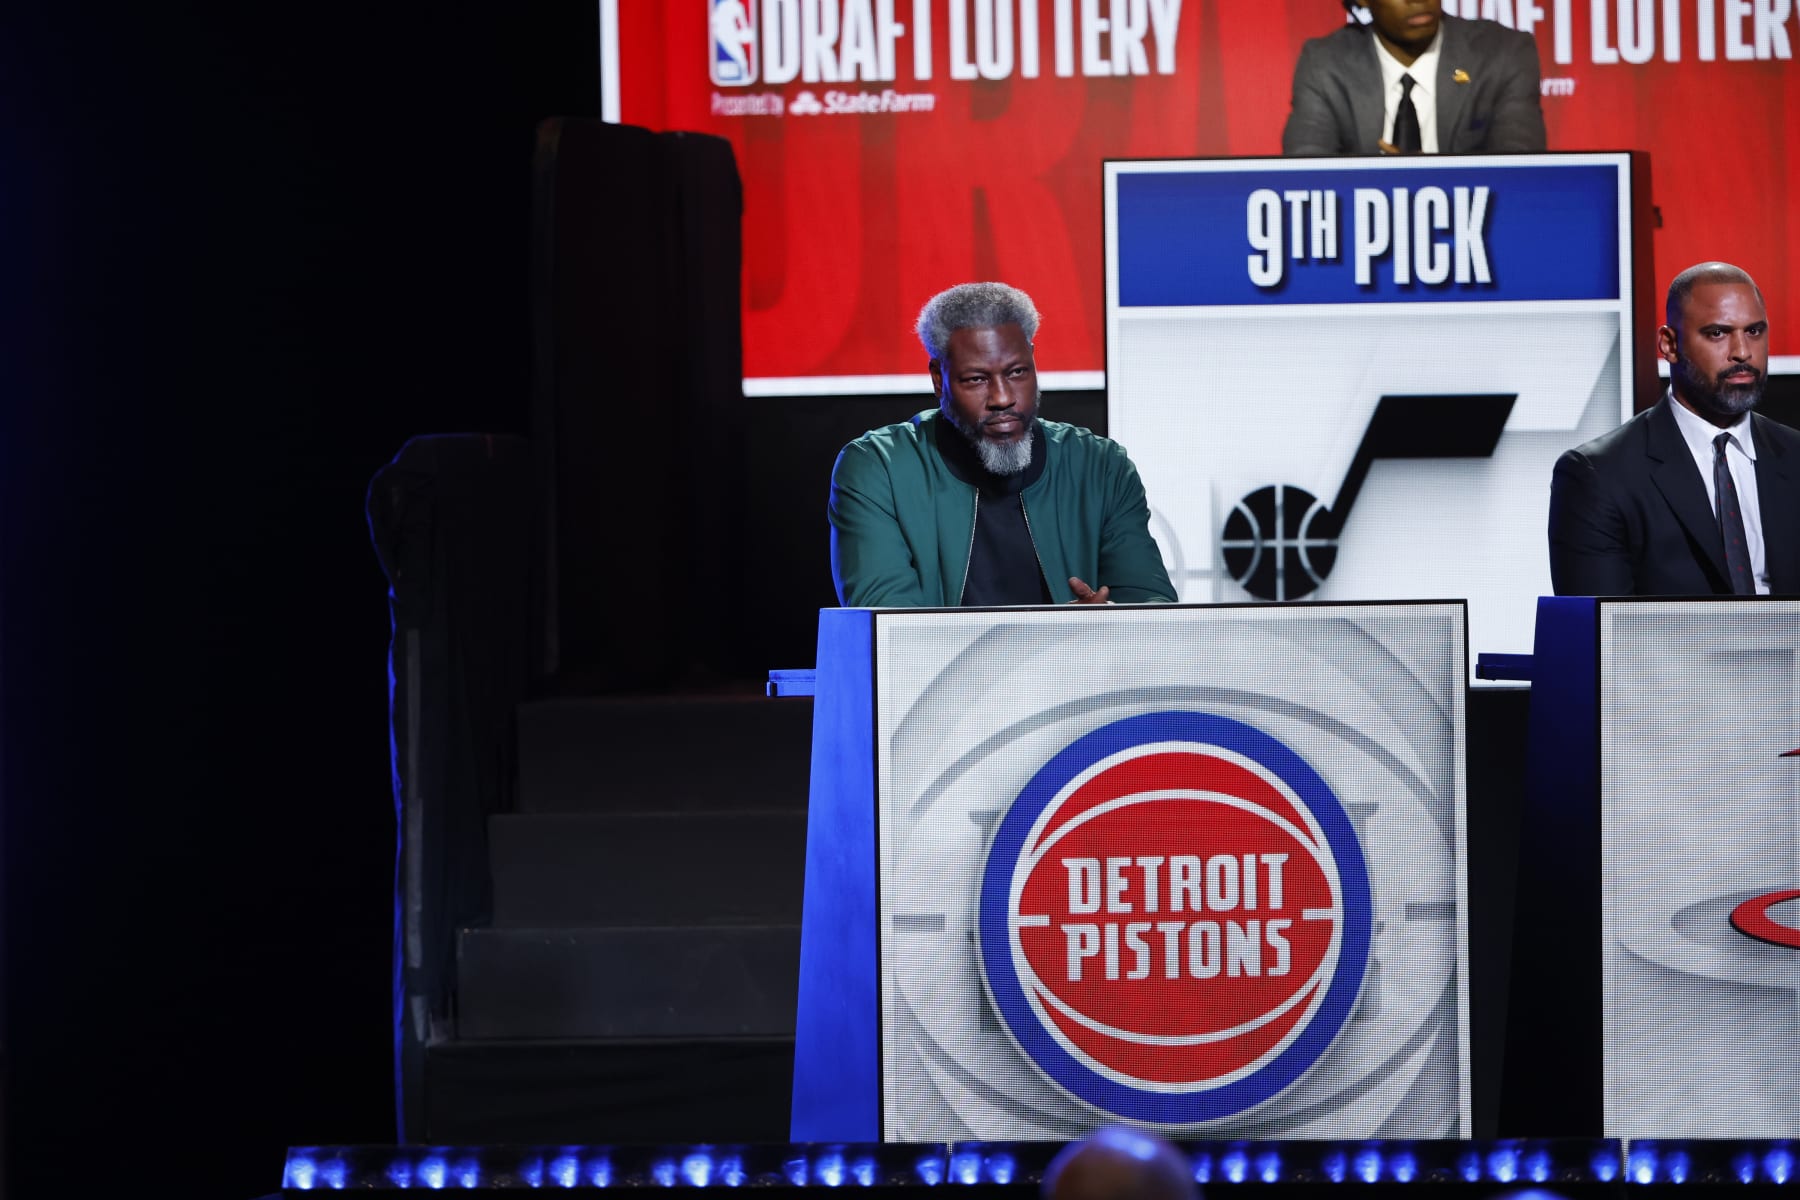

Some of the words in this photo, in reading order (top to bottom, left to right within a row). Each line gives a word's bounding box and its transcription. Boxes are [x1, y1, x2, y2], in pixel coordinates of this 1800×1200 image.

[763, 0, 932, 83] DRAFT
[949, 0, 1182, 80] LOTTERY
[1591, 0, 1800, 64] LOTTER
[1247, 188, 1337, 287] 9TH
[1354, 186, 1491, 285] PICK
[1061, 853, 1289, 914] DETROIT
[1061, 919, 1292, 982] PISTONS
